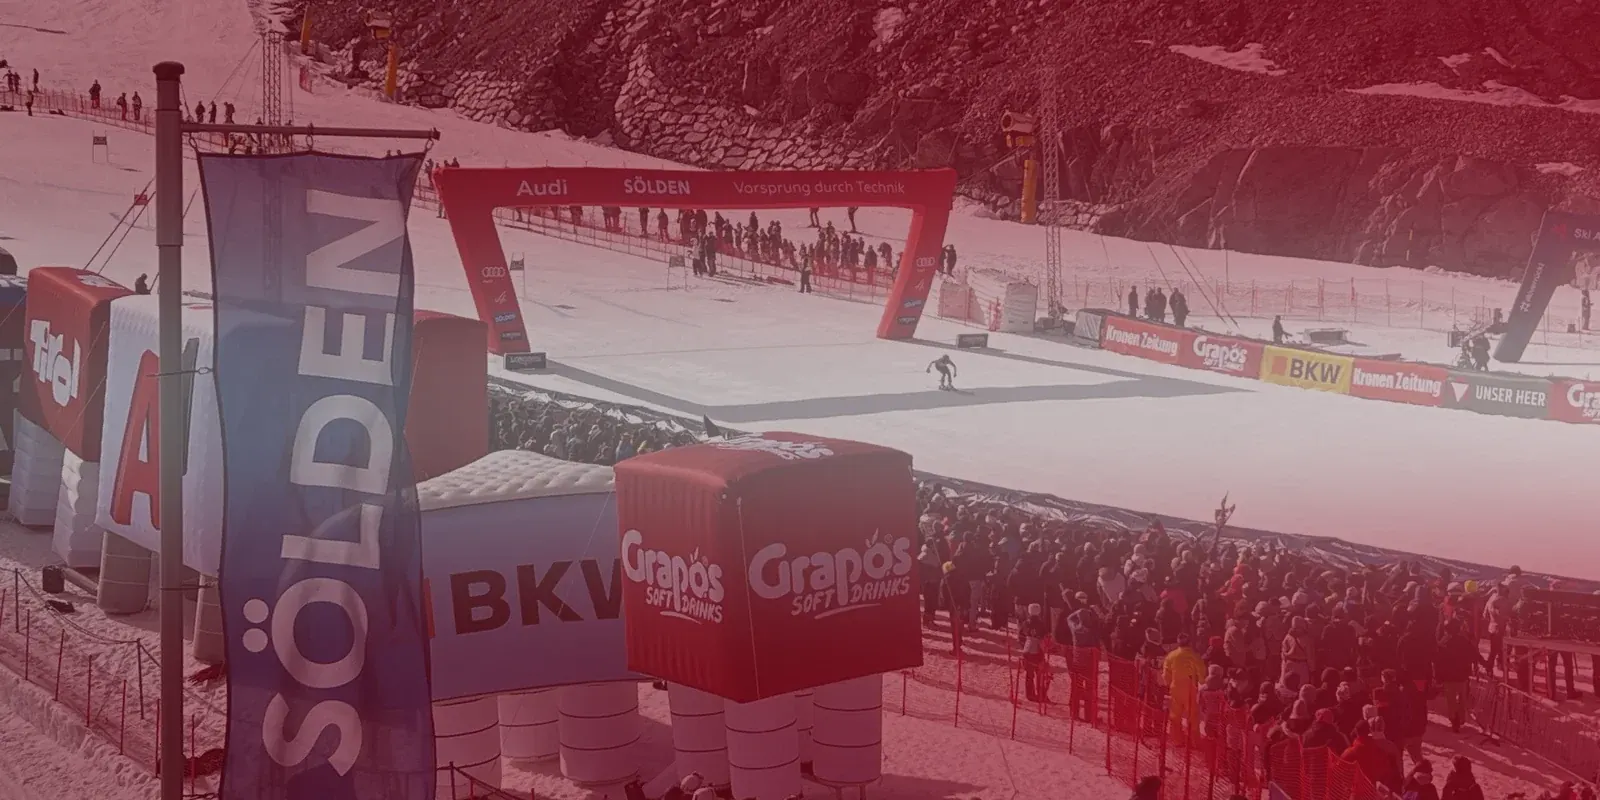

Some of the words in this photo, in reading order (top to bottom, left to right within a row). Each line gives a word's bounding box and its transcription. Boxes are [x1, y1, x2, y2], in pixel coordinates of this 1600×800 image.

[516, 179, 568, 197] Audi
[623, 176, 691, 195] SÖLDEN
[732, 181, 811, 196] Vorsprung
[814, 181, 854, 193] durch
[856, 181, 905, 194] Technik
[1105, 324, 1141, 347] Kronen
[1140, 331, 1178, 357] Zeitung
[30, 319, 81, 407] Tirol
[1289, 357, 1341, 384] BKW
[1353, 367, 1394, 390] Kronen
[1395, 372, 1442, 398] Zeitung
[1475, 384, 1513, 404] UNSER
[1515, 389, 1546, 407] HEER
[243, 188, 407, 776] SÖLDEN
[621, 529, 725, 612] Grapos
[645, 586, 673, 608] SOFT
[681, 595, 723, 623] DRINKS
[791, 588, 836, 616] SOFT
[849, 576, 910, 604] DRINKS
